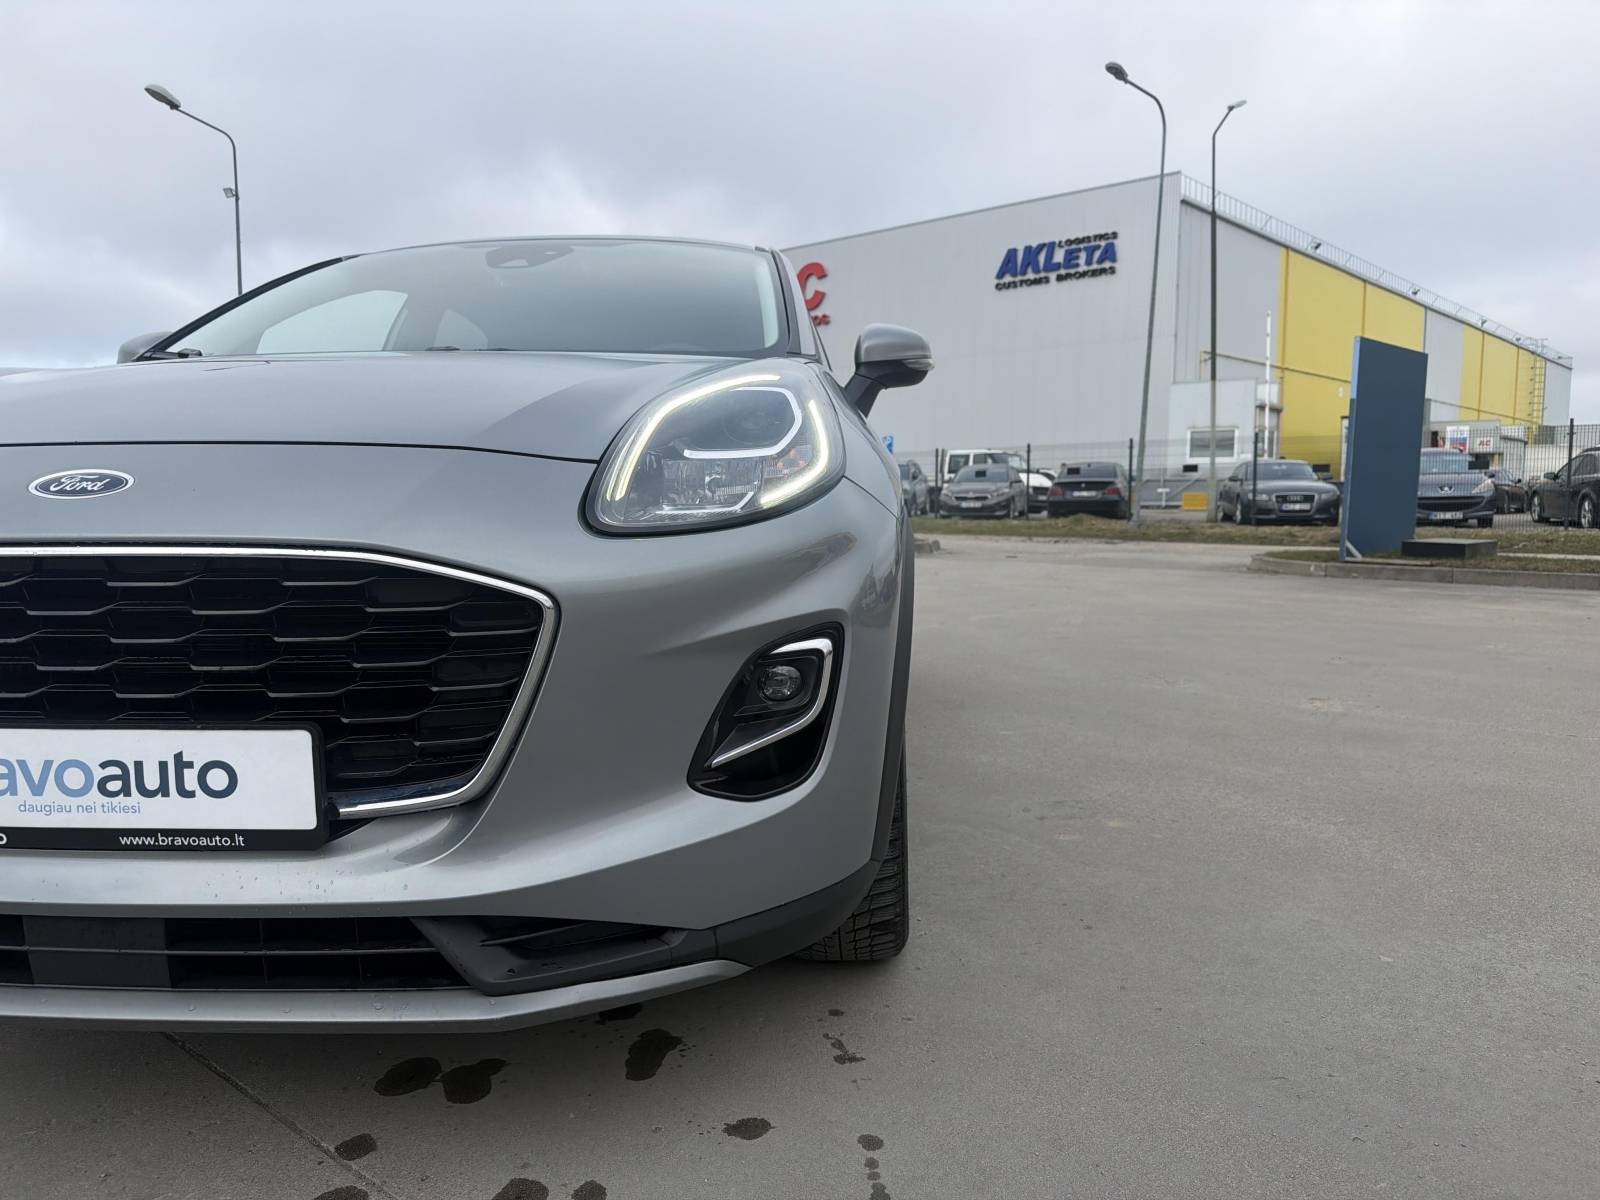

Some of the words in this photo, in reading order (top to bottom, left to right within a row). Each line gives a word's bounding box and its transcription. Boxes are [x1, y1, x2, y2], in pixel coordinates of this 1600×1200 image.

[1057, 232, 1118, 249] LOGISTICS
[996, 241, 1117, 280] AKLETA
[995, 276, 1050, 291] CUSTOMS
[1056, 266, 1116, 283] BROKERS
[49, 475, 111, 492] Ford
[18, 800, 72, 816] daugiau
[76, 802, 97, 814] nei
[101, 802, 141, 814] tikiesi
[118, 833, 245, 847] www.bravoauto.lt
